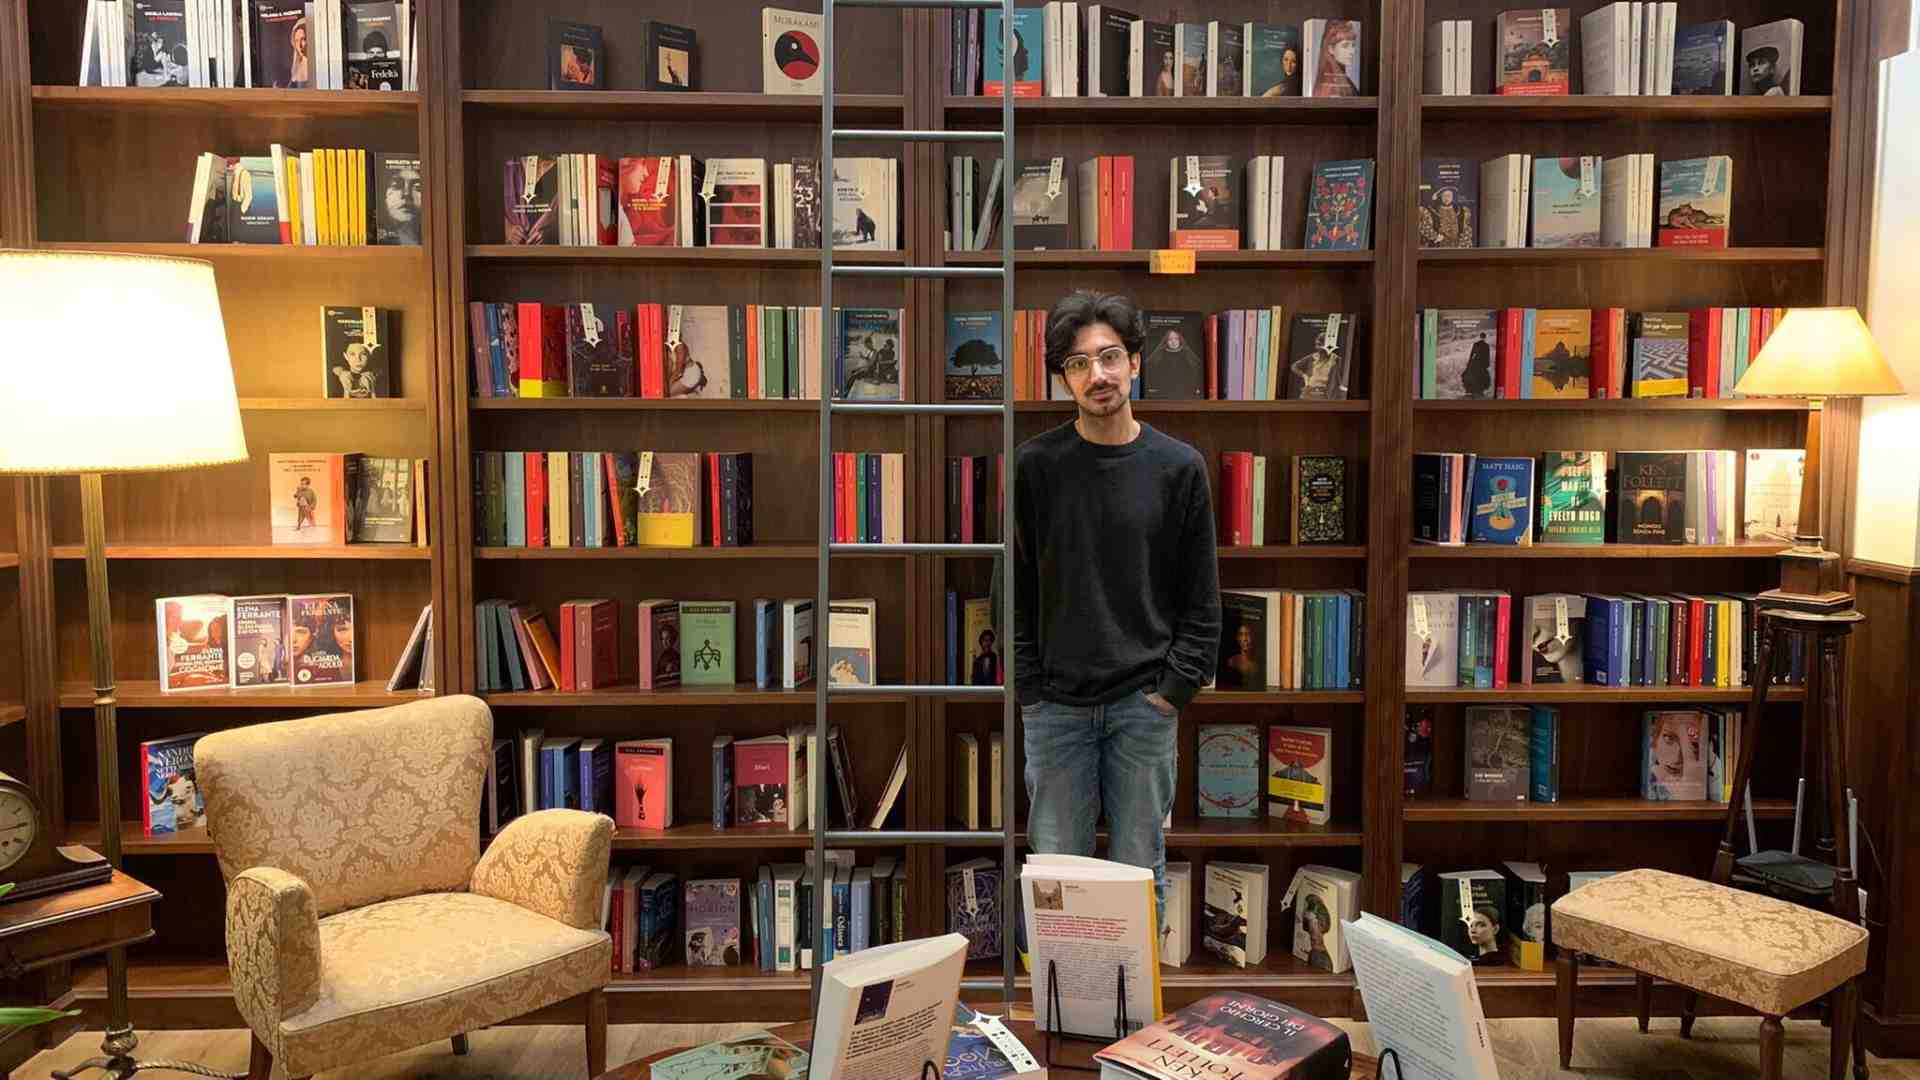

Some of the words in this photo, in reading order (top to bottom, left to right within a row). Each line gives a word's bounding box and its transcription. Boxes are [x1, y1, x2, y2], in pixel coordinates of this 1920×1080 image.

[773, 15, 819, 28] MURAKAMI
[1639, 464, 1666, 476] KEN
[1623, 475, 1684, 488] FOLLETT
[1549, 511, 1575, 521] EVELYN
[1579, 511, 1601, 521] HUGO
[237, 610, 281, 619] FERRANTE
[180, 653, 224, 663] FERRANTE
[1228, 1000, 1281, 1023] GIORNI
[1220, 1006, 1281, 1032] CERCHIO
[1284, 1029, 1298, 1039] IL
[1153, 1055, 1201, 1079] KEN
